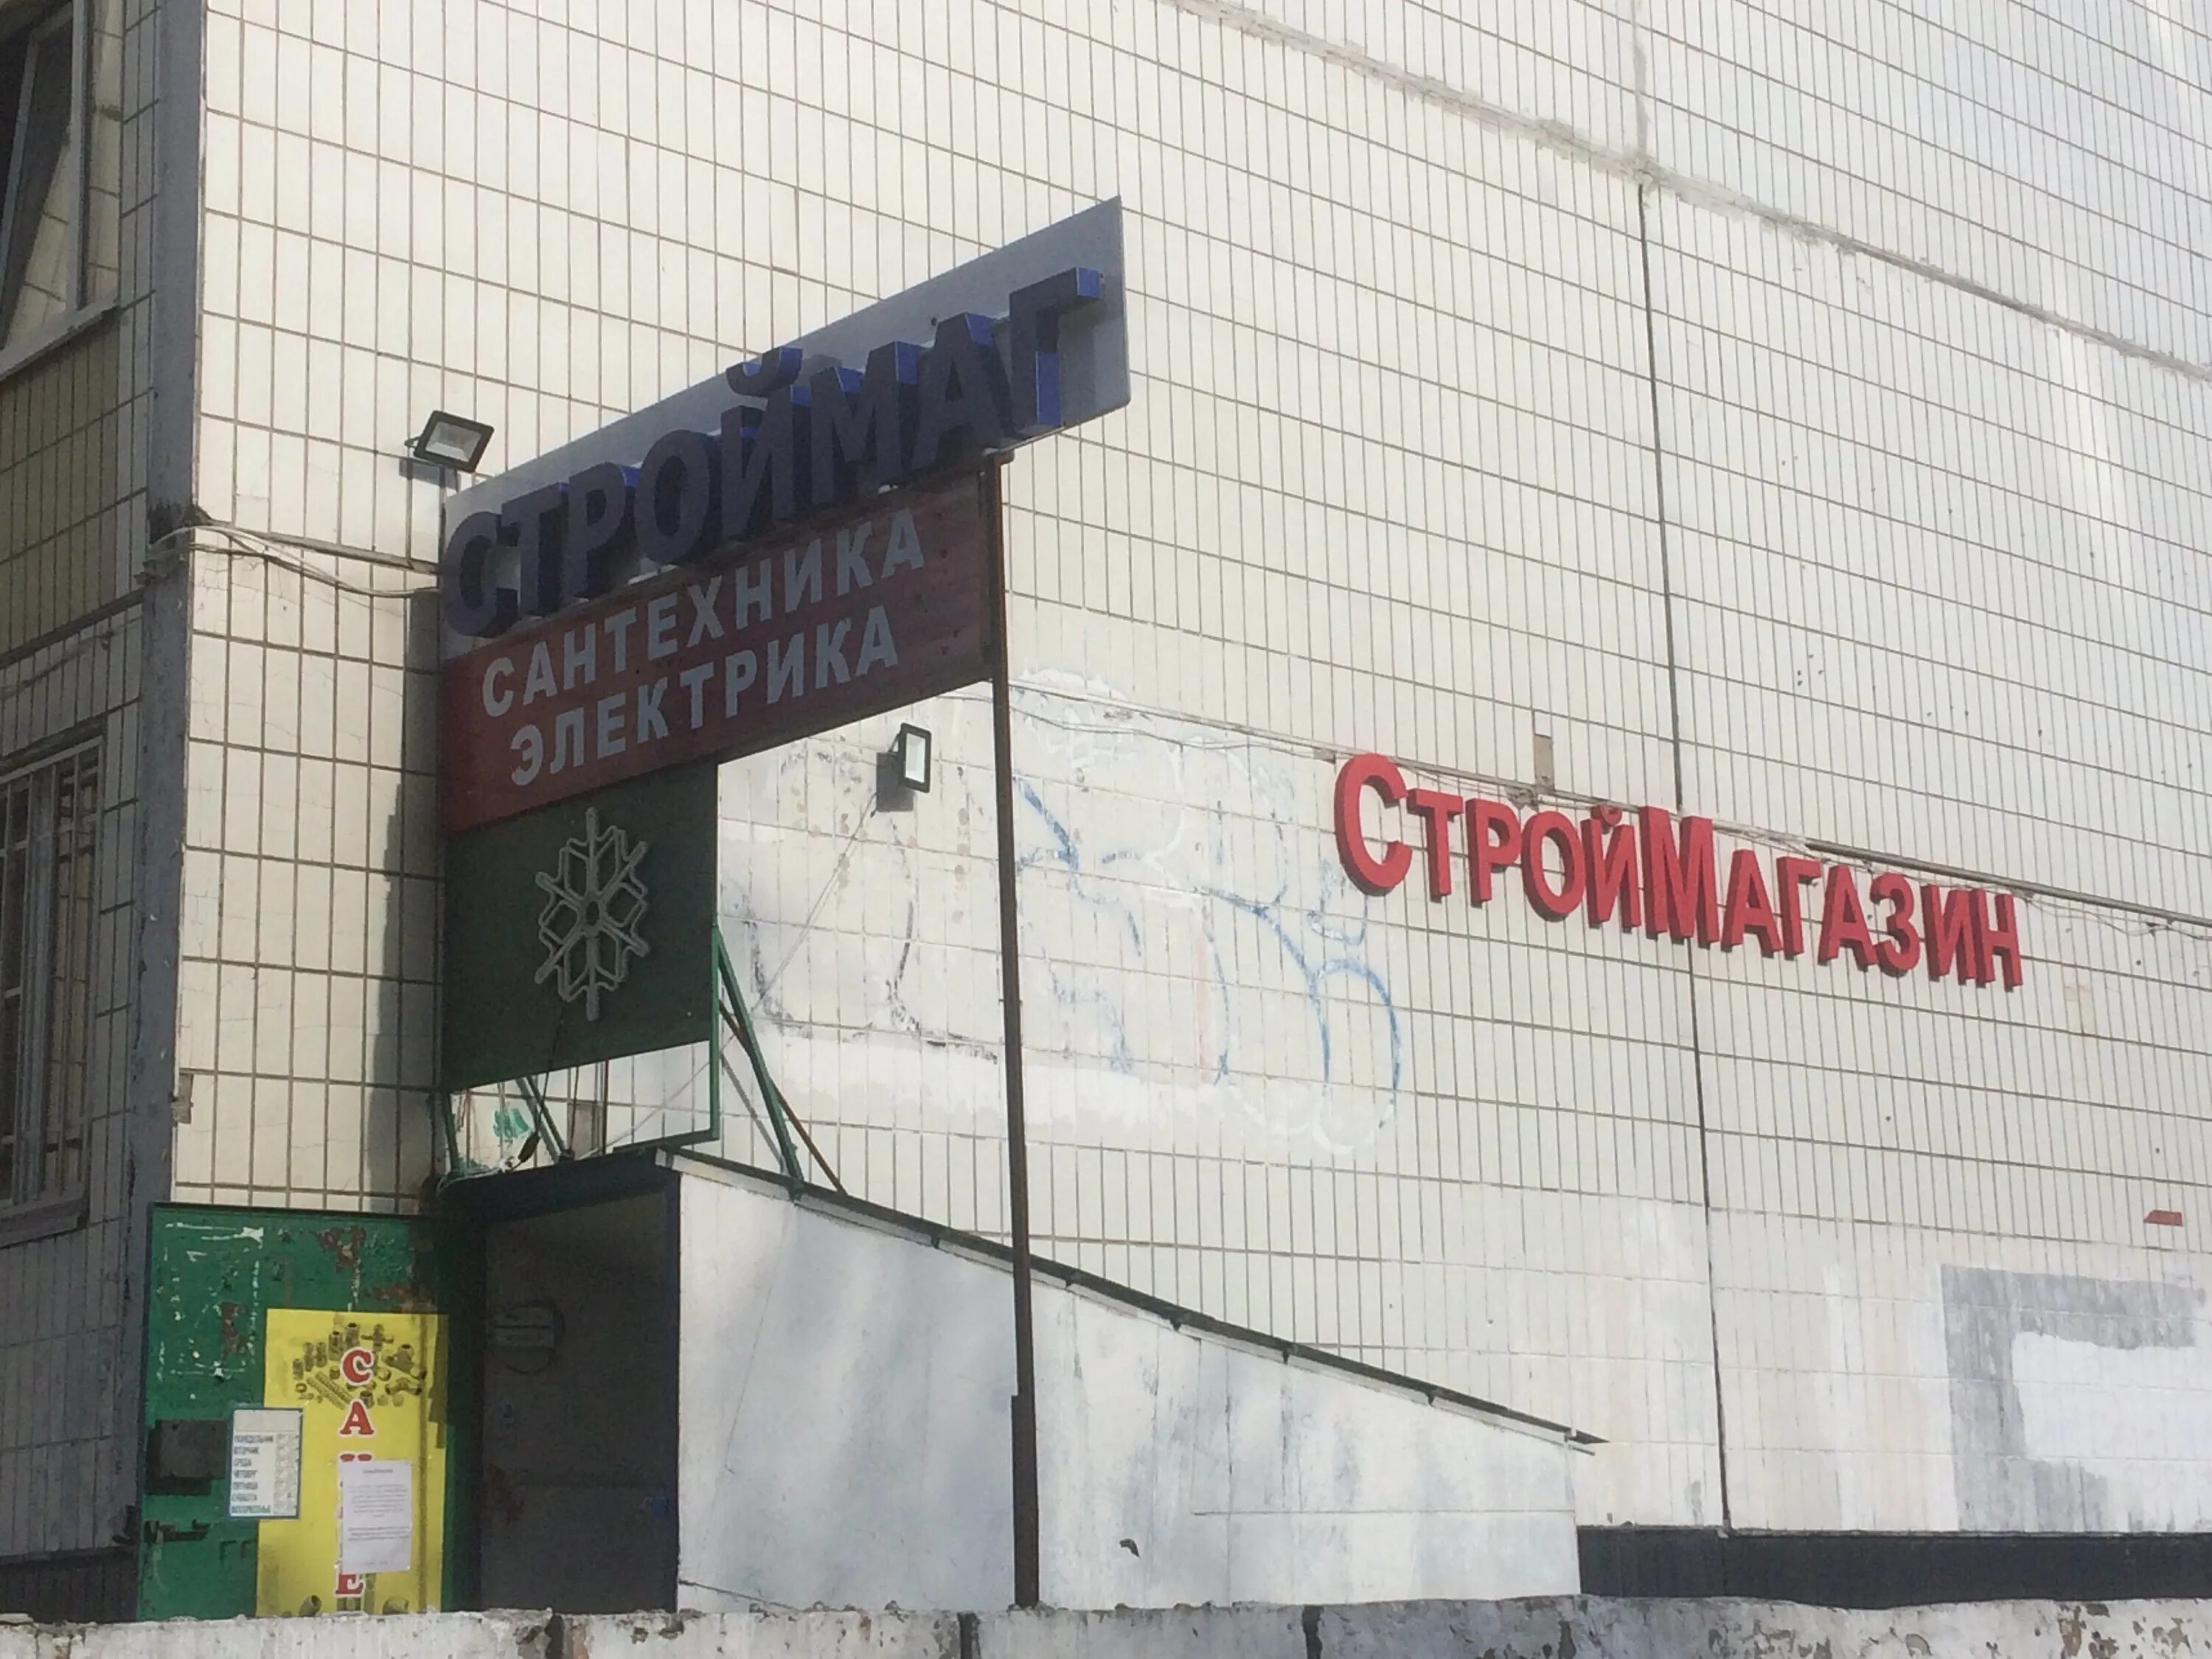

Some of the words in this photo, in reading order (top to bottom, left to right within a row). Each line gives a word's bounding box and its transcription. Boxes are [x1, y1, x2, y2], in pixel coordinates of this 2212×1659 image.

[446, 267, 1099, 639] СТРОЙМАГ
[483, 508, 925, 717] САНТЕХНИКА
[510, 605, 898, 787] ЭЛЕКТРИКА
